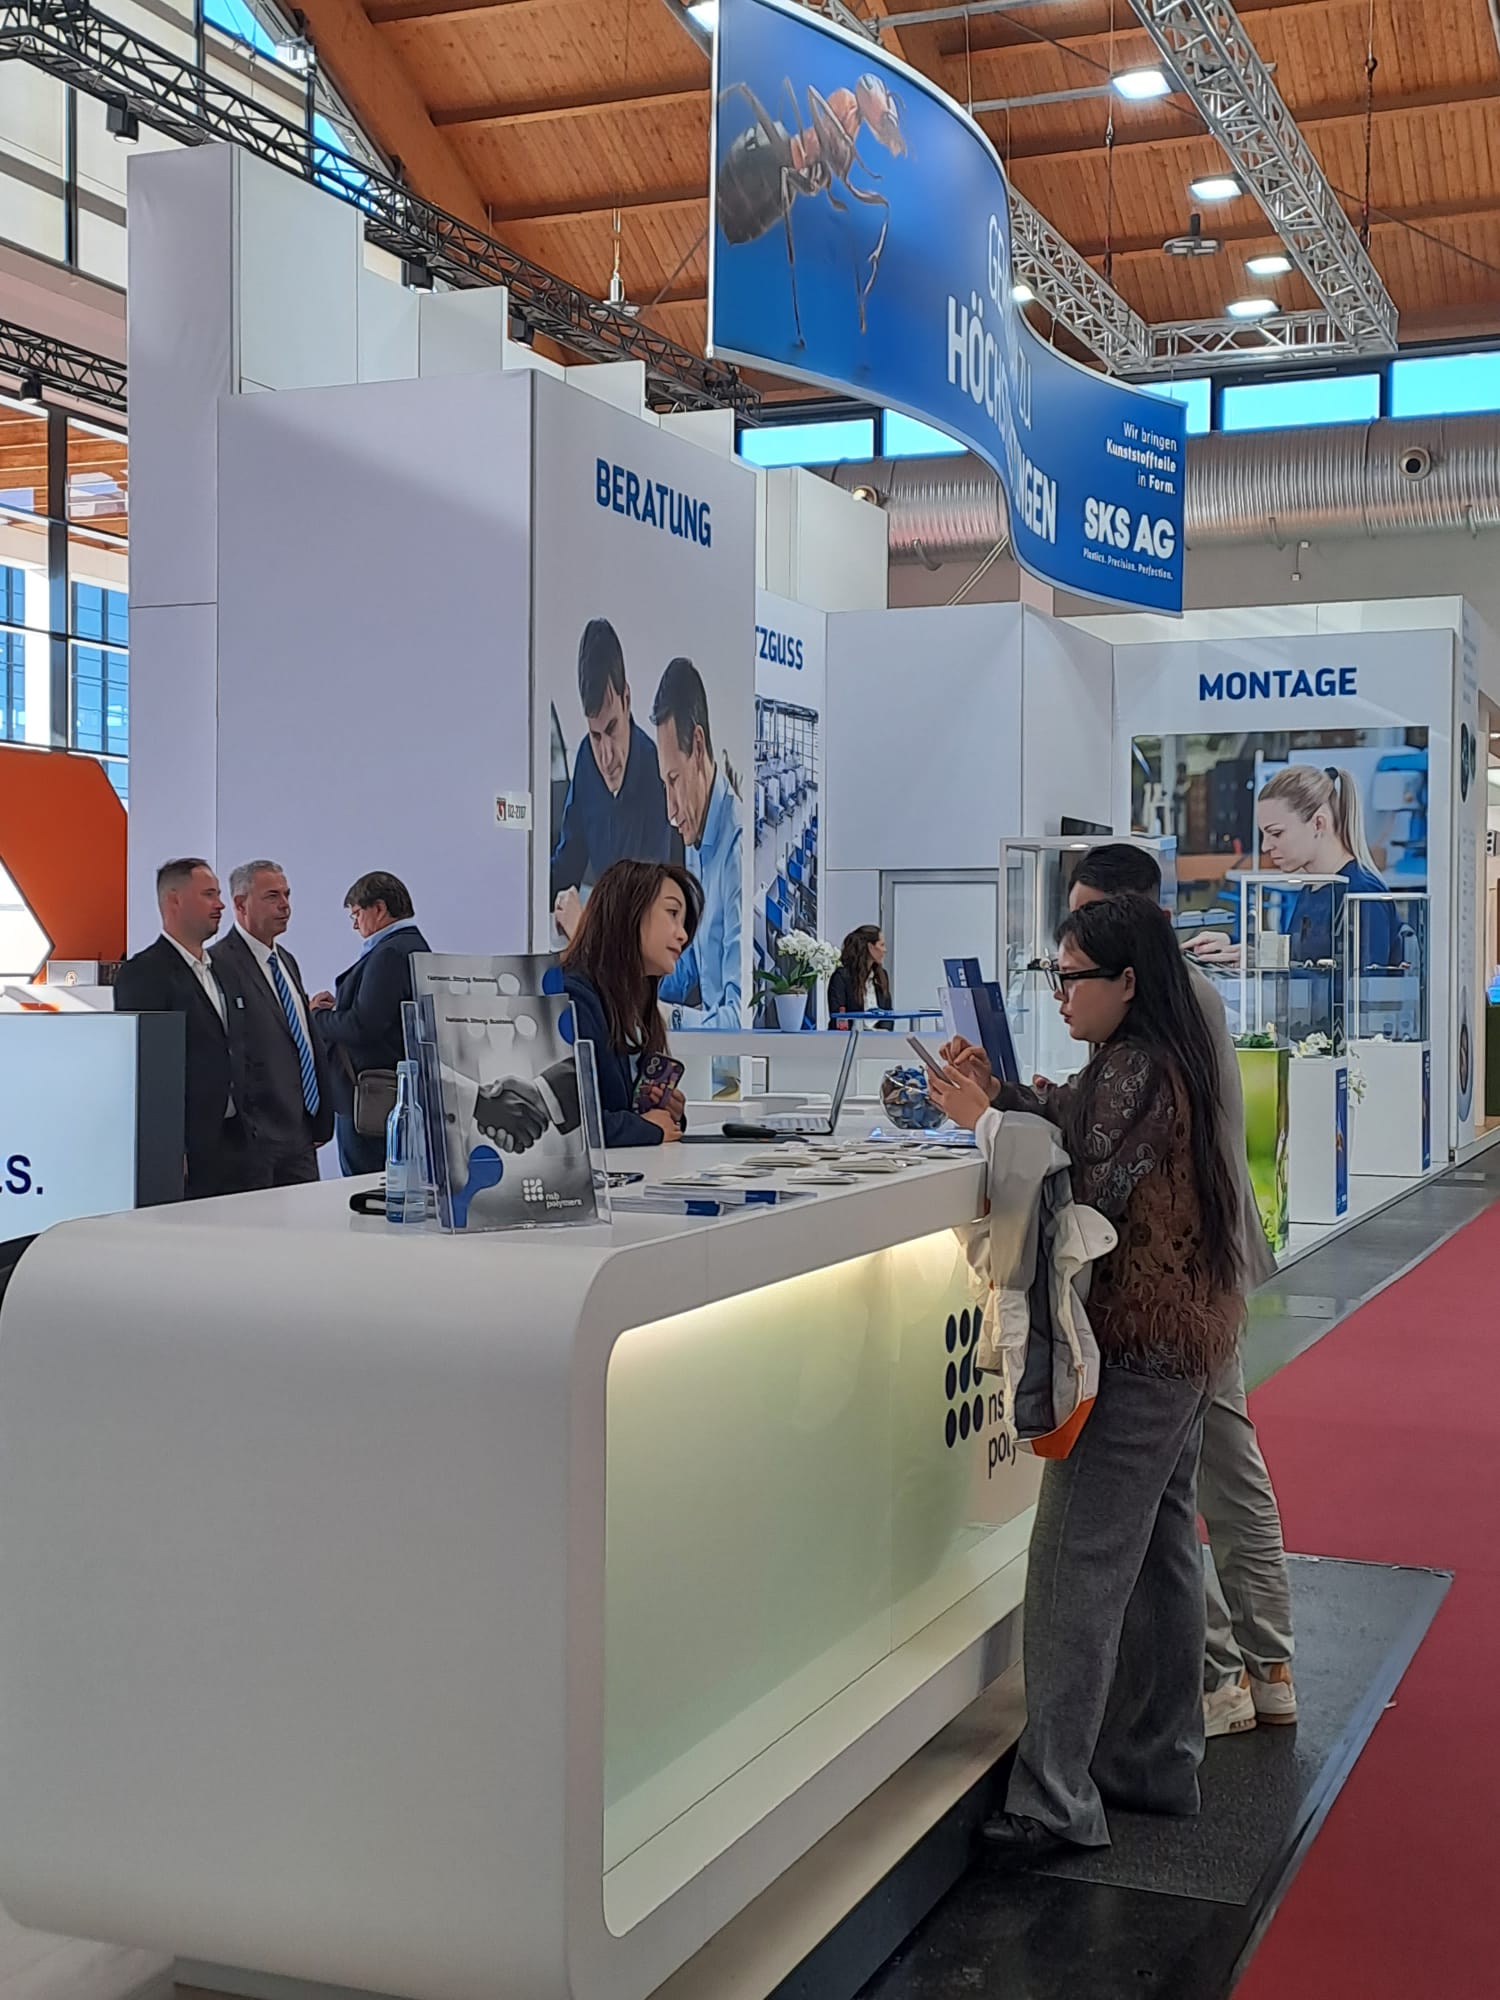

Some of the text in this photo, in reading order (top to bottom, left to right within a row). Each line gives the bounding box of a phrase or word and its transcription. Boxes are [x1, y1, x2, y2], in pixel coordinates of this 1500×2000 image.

[1123, 421, 1177, 452] Wir bringen
[1106, 437, 1177, 473] Kunststoffteile
[1137, 469, 1176, 495] in Form.
[596, 457, 711, 548] BERATUNG
[1084, 497, 1175, 560] SKS AG
[1199, 667, 1358, 701] MONTAGE
[988, 1389, 1005, 1426] ns
